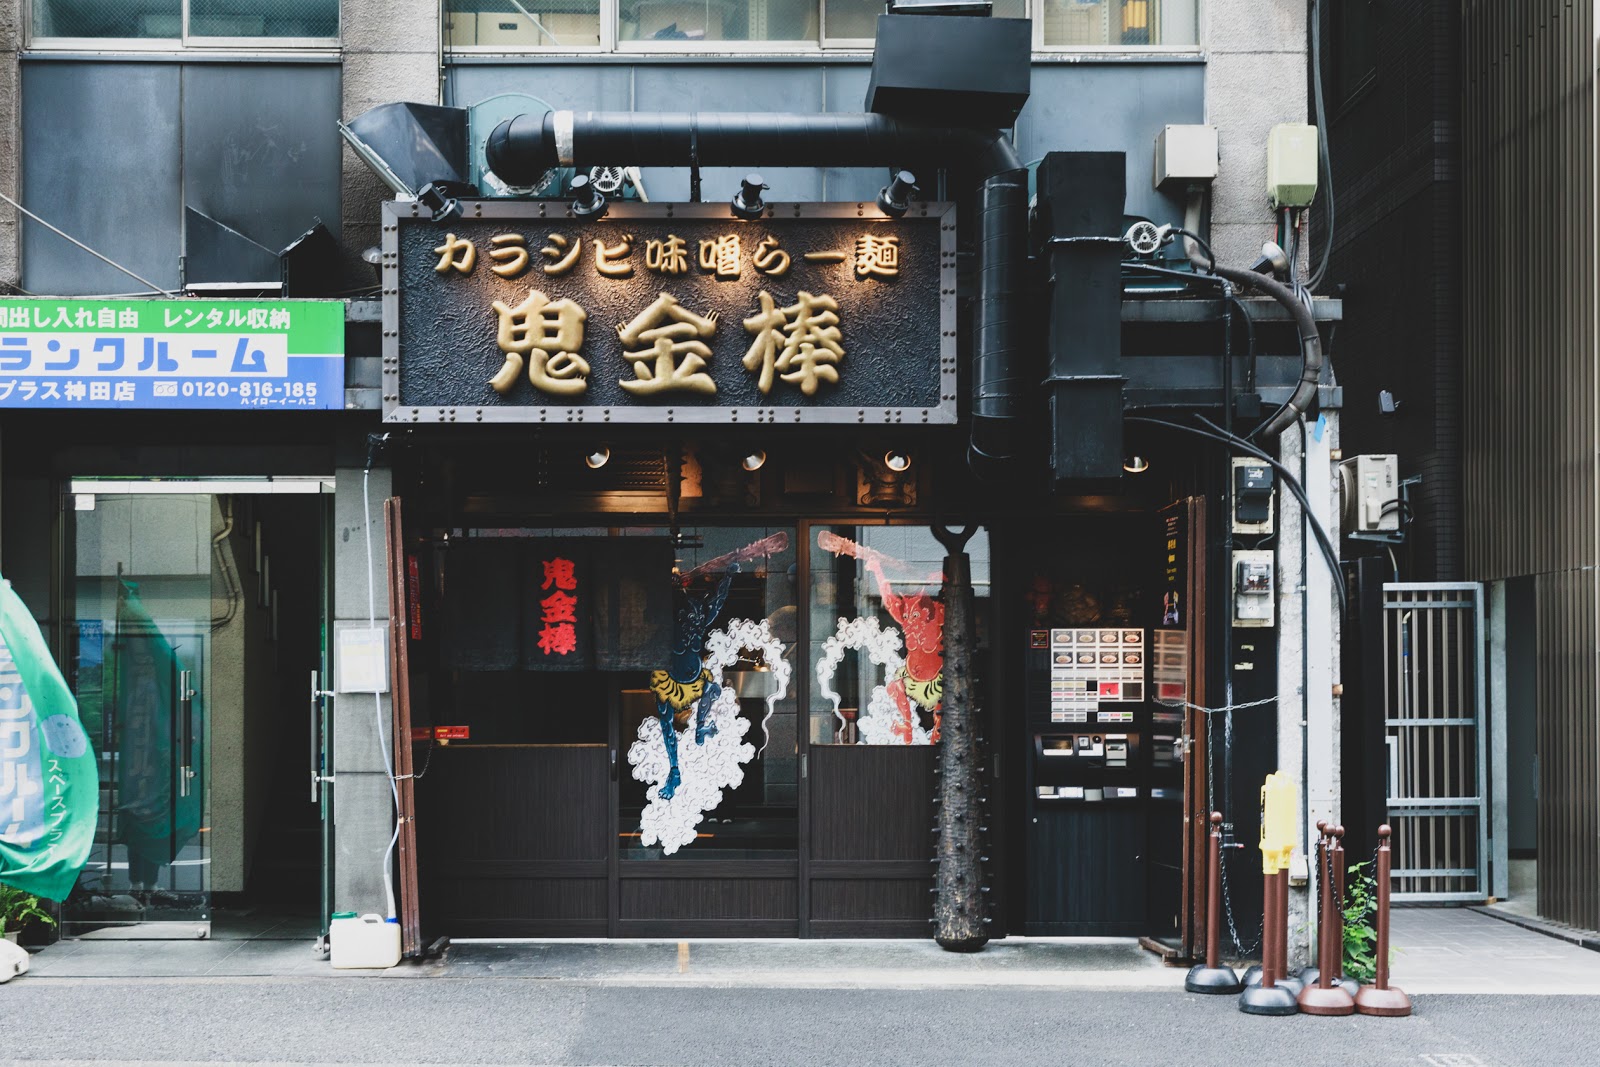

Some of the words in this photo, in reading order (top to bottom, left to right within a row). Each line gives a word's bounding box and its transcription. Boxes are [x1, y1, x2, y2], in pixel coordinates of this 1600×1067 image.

[164, 308, 291, 330] レンタル収納
[0, 337, 268, 373] ランクルーム
[488, 289, 846, 396] 鬼金棒
[0, 379, 136, 402] プラス神田店
[182, 381, 317, 399] 0120-816-185
